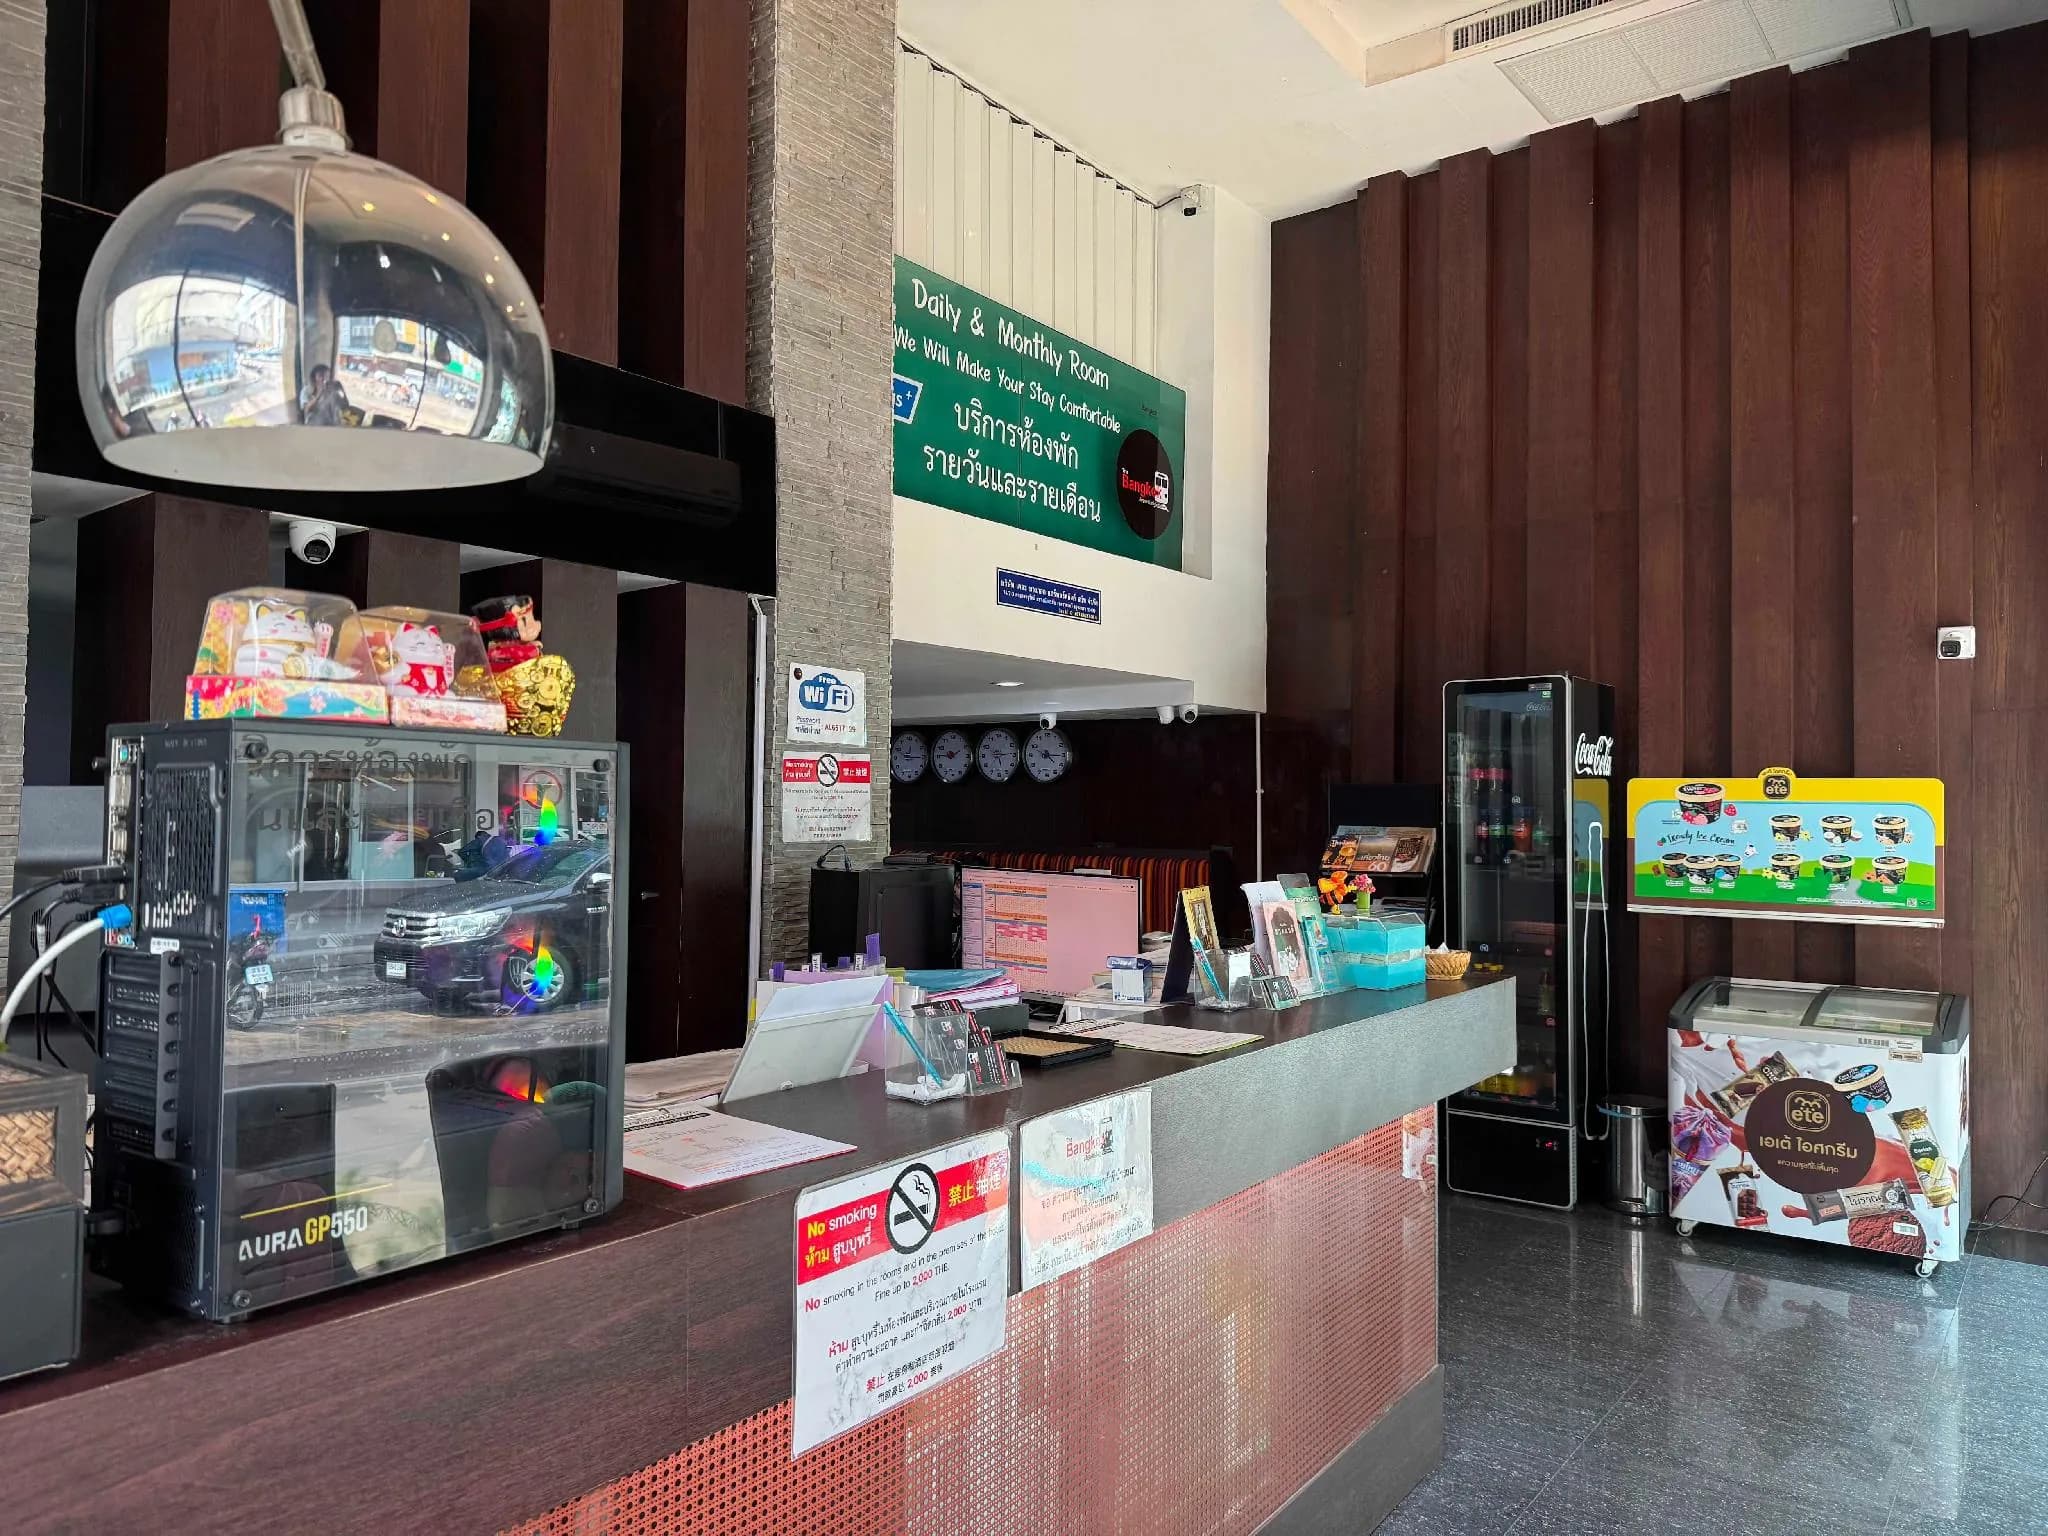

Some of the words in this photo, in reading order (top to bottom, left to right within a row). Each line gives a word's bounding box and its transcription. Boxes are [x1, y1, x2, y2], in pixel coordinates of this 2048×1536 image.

[912, 278, 962, 333] Daily
[970, 307, 985, 338] &
[998, 316, 1063, 376] Monthly
[1068, 350, 1110, 390] Room
[893, 324, 916, 352] We
[923, 336, 950, 367] Will
[956, 351, 991, 382] Make
[997, 366, 1025, 395] Your
[1029, 381, 1055, 412] Stay
[1059, 393, 1121, 434] Comfortable
[954, 398, 1079, 470] บริการห้องพัก
[923, 445, 1102, 523] รายวันและรายเดือน
[804, 686, 825, 704] Wi
[832, 689, 848, 706] Fi
[819, 675, 837, 685] Free
[1667, 830, 1692, 844] Trendy
[1710, 833, 1735, 845] Cream
[1759, 1135, 1792, 1151] เอเต้
[1796, 1136, 1858, 1159] ไอศกรีม
[948, 1183, 975, 1208] 禁止
[239, 1227, 304, 1262] AURA
[304, 1206, 368, 1246] GP550
[807, 1222, 826, 1240] No
[828, 1202, 877, 1231] smoking
[805, 1245, 829, 1269] ห้าม
[832, 1221, 873, 1265] สูบบุหรี่
[805, 1296, 821, 1312] No
[823, 1287, 855, 1307] smoking
[857, 1280, 864, 1292] in
[879, 1266, 902, 1283] rooms
[903, 1257, 917, 1273] and
[918, 1255, 925, 1268] in
[926, 1250, 937, 1264] the
[939, 1240, 968, 1259] premises
[977, 1231, 986, 1242] the
[875, 1288, 890, 1302] Fine
[892, 1284, 902, 1297] up
[903, 1279, 911, 1290] to
[912, 1269, 933, 1288] 2,000
[947, 1304, 967, 1321] 2,000
[828, 1339, 849, 1358] ห้าม
[907, 1370, 929, 1389] 2,000
